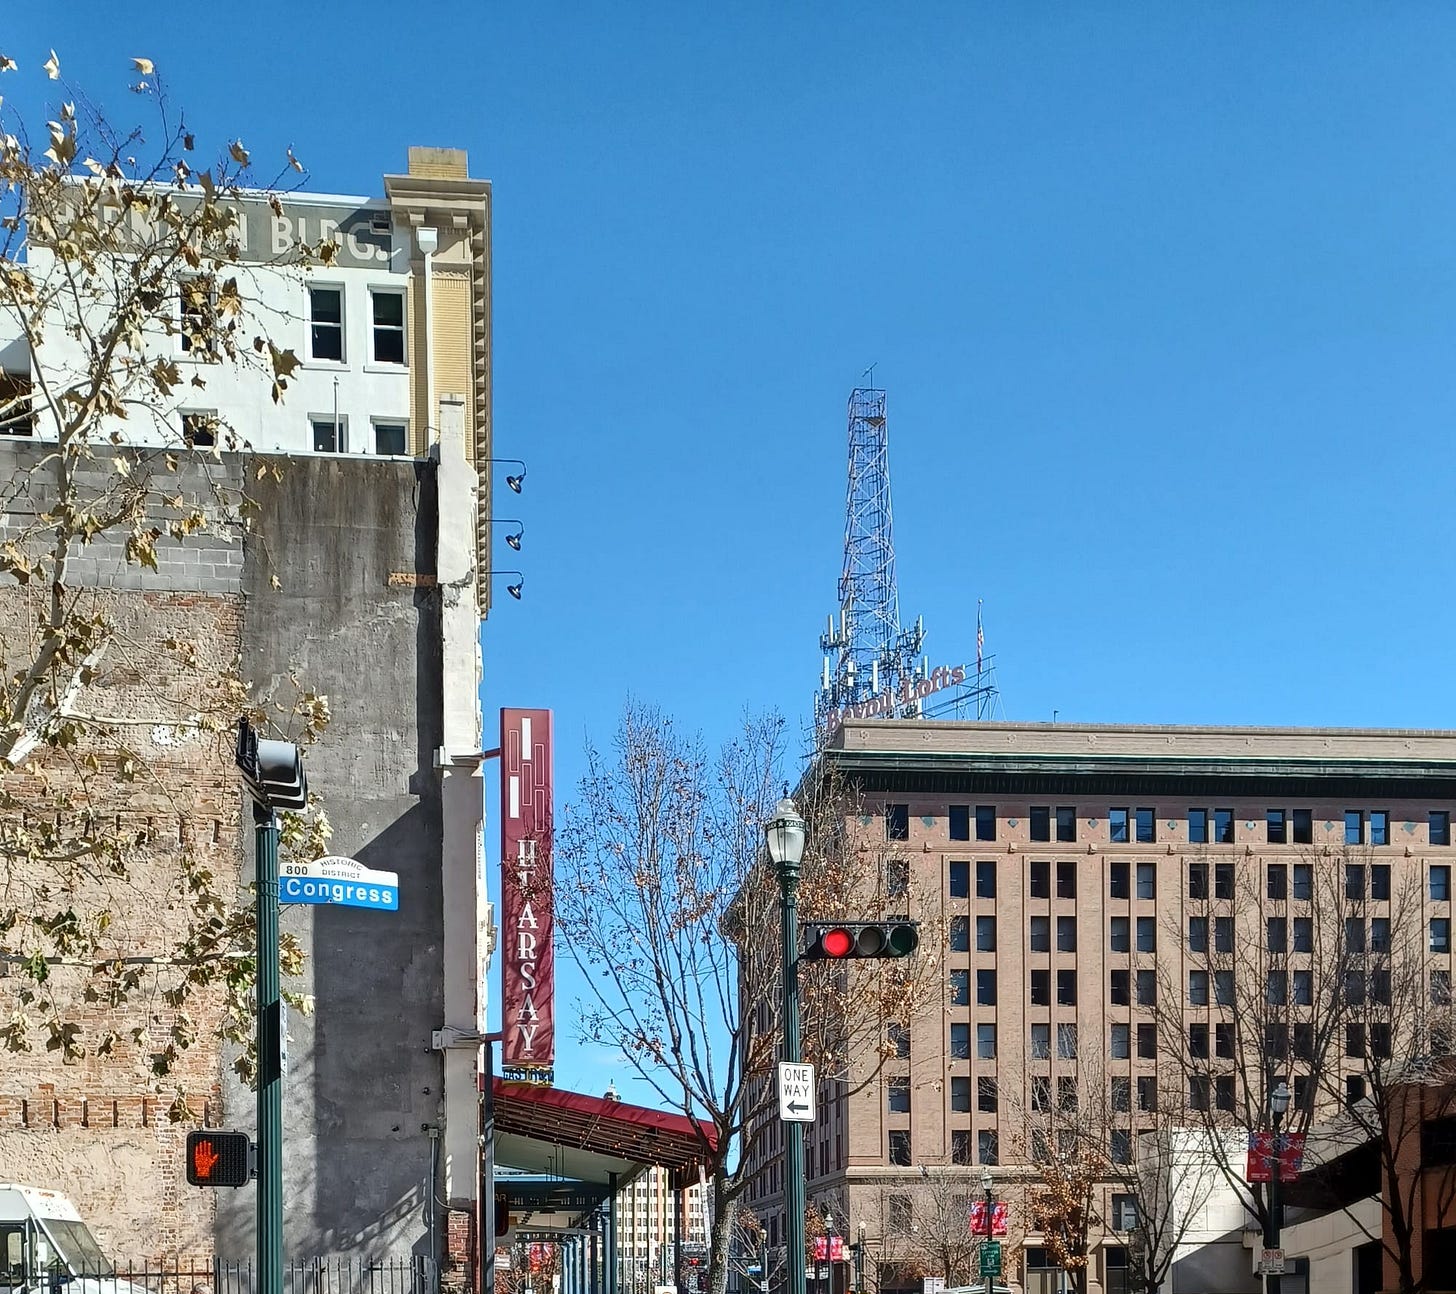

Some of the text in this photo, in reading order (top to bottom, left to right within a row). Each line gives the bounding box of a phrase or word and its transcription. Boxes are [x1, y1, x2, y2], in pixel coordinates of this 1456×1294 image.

[47, 197, 248, 252] HRMN
[899, 664, 966, 704] Lofts
[286, 865, 308, 875] 800
[320, 859, 363, 871] HISTORIC
[321, 869, 361, 879] DISTRICT
[286, 878, 393, 904] Congress
[784, 1068, 809, 1082] ONE
[783, 1084, 810, 1097] WAY
